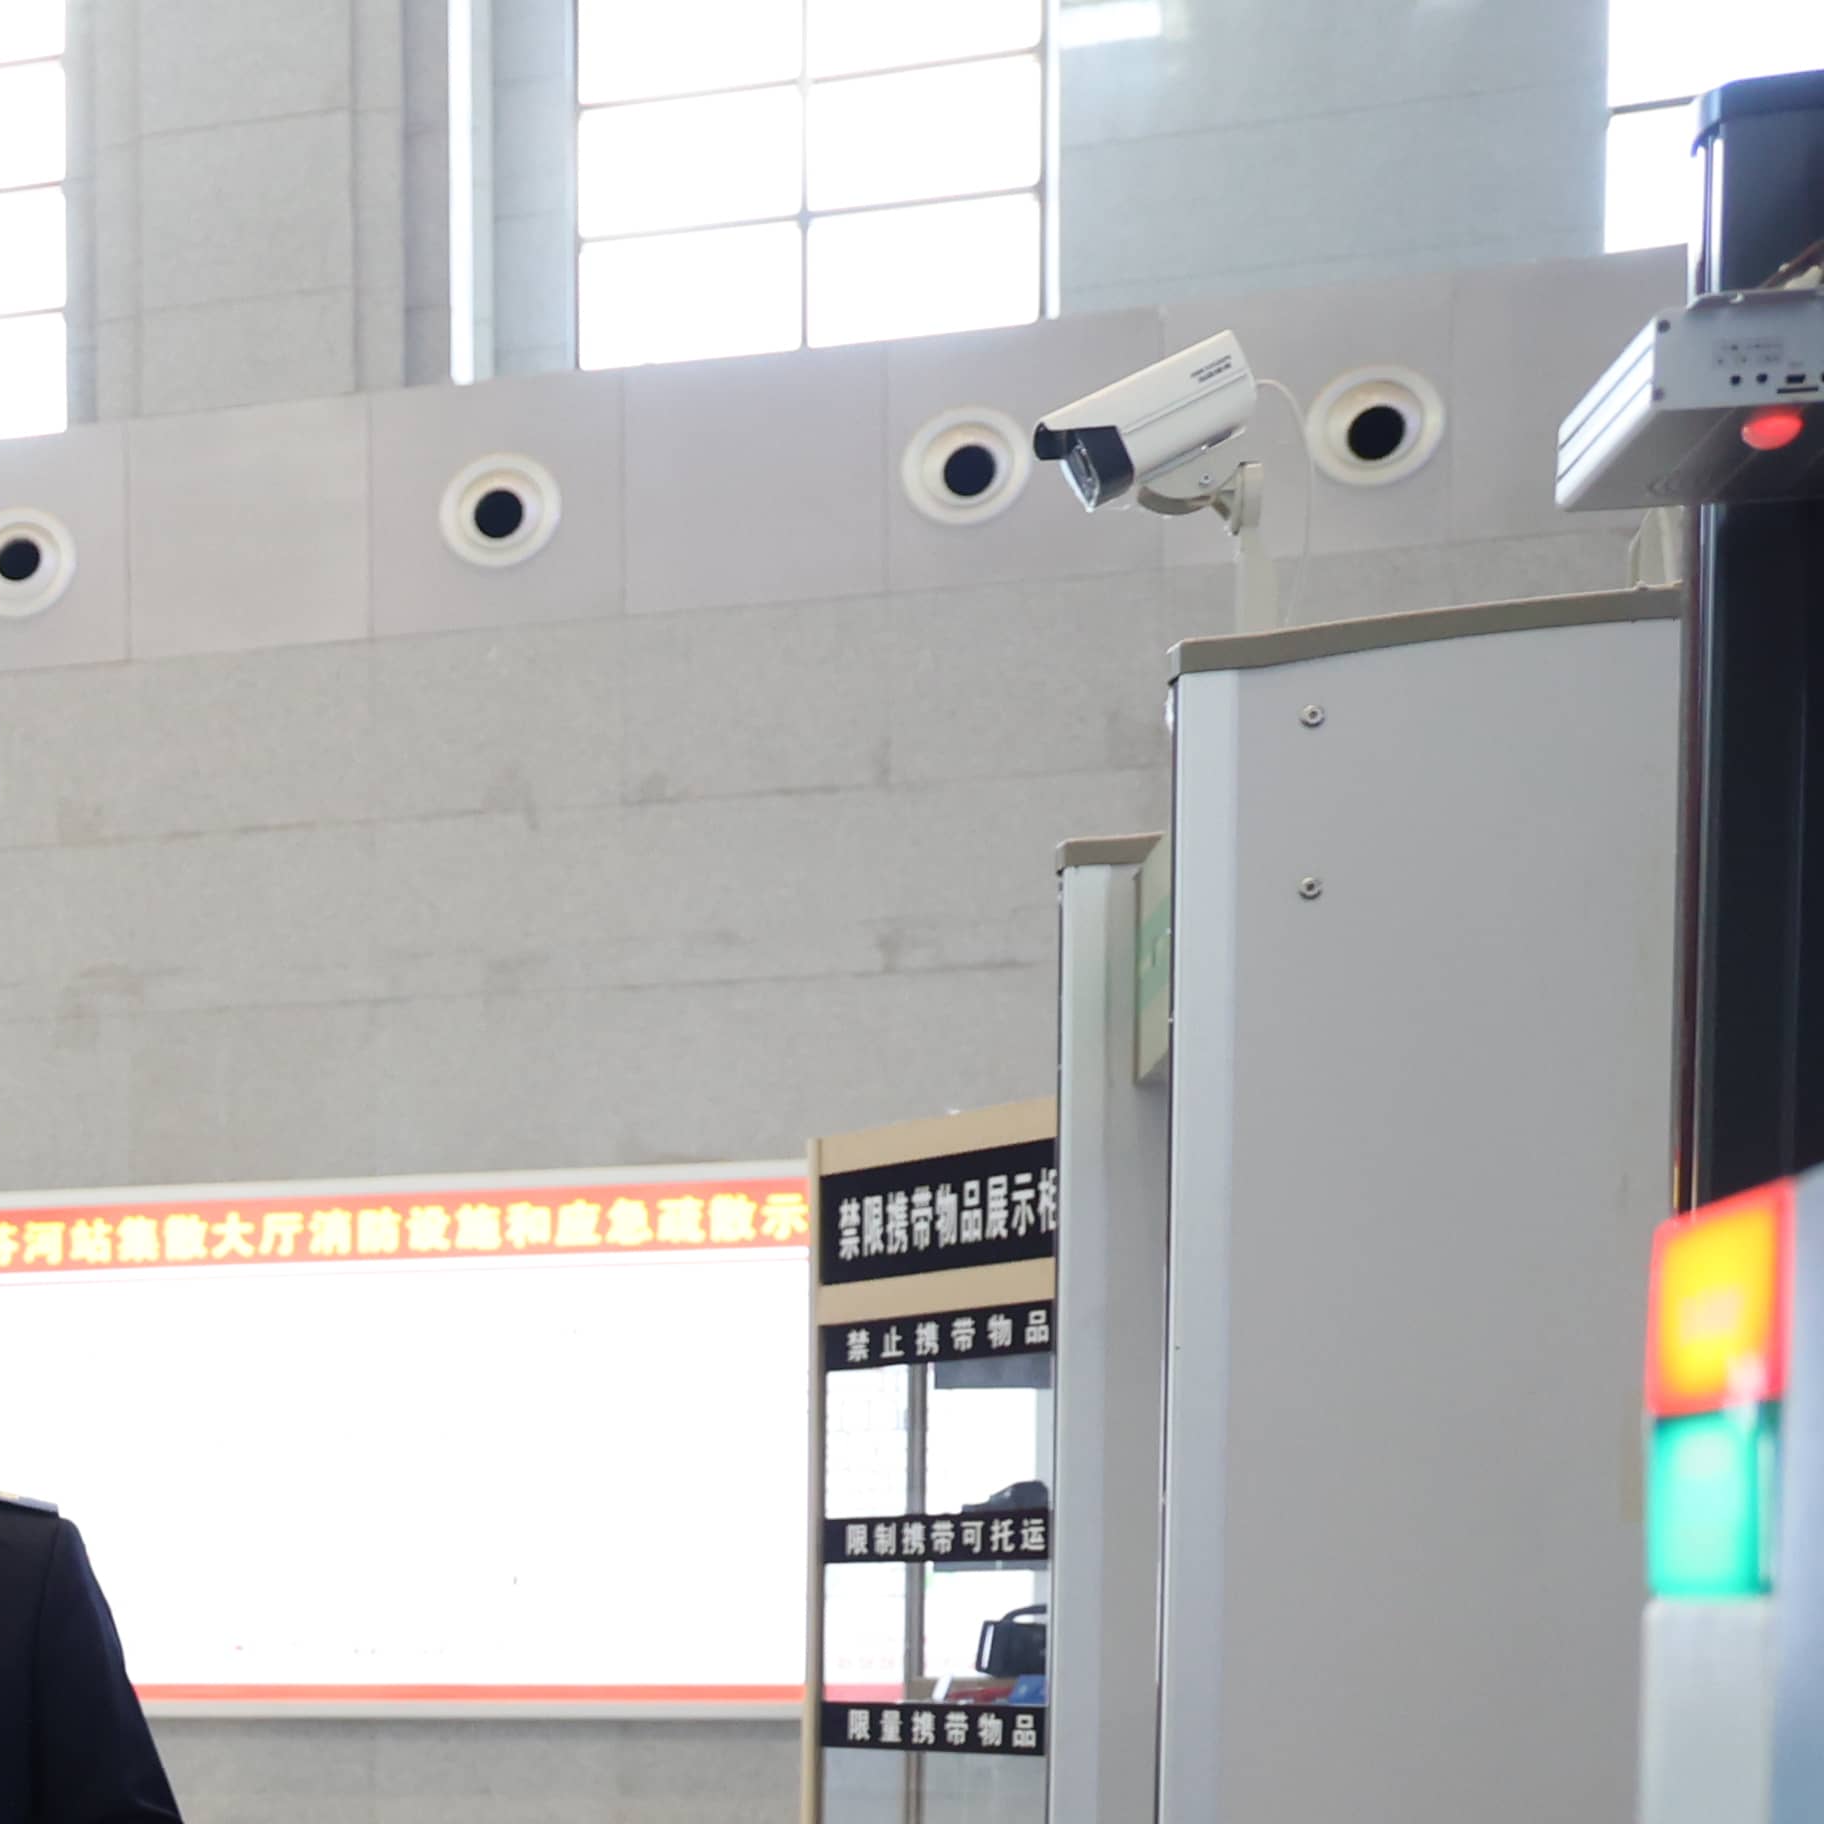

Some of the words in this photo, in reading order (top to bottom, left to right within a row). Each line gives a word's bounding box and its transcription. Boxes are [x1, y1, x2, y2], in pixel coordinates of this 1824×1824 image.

[847, 1309, 1050, 1363] 禁止携带物品
[845, 1517, 1047, 1557] 限制携带可托运
[847, 1708, 1037, 1747] 限量携带物品
